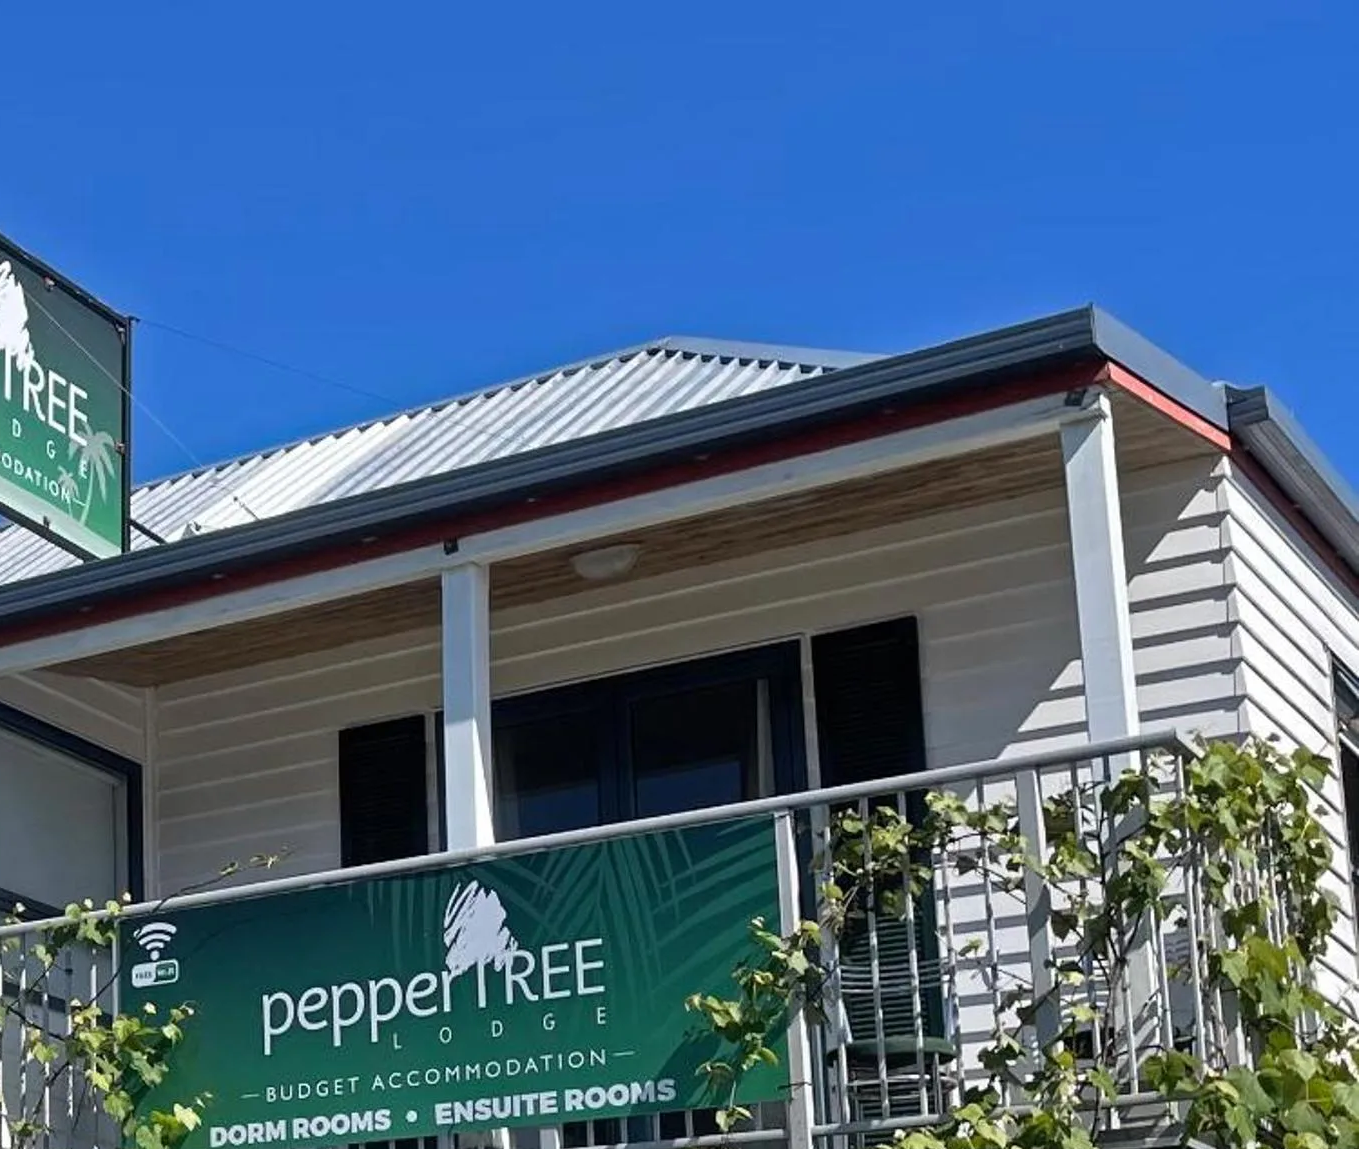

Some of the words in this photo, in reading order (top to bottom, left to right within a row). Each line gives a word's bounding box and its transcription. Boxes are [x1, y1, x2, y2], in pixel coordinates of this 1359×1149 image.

[393, 1006, 607, 1050] LODGE
[265, 1076, 360, 1103] BUDGET
[371, 1049, 607, 1092] ACCOMMODATION
[209, 1119, 288, 1149] DORM
[292, 1108, 392, 1140] ROOMS
[434, 1090, 559, 1126] ENSUITE
[564, 1078, 678, 1112] ROOMS
